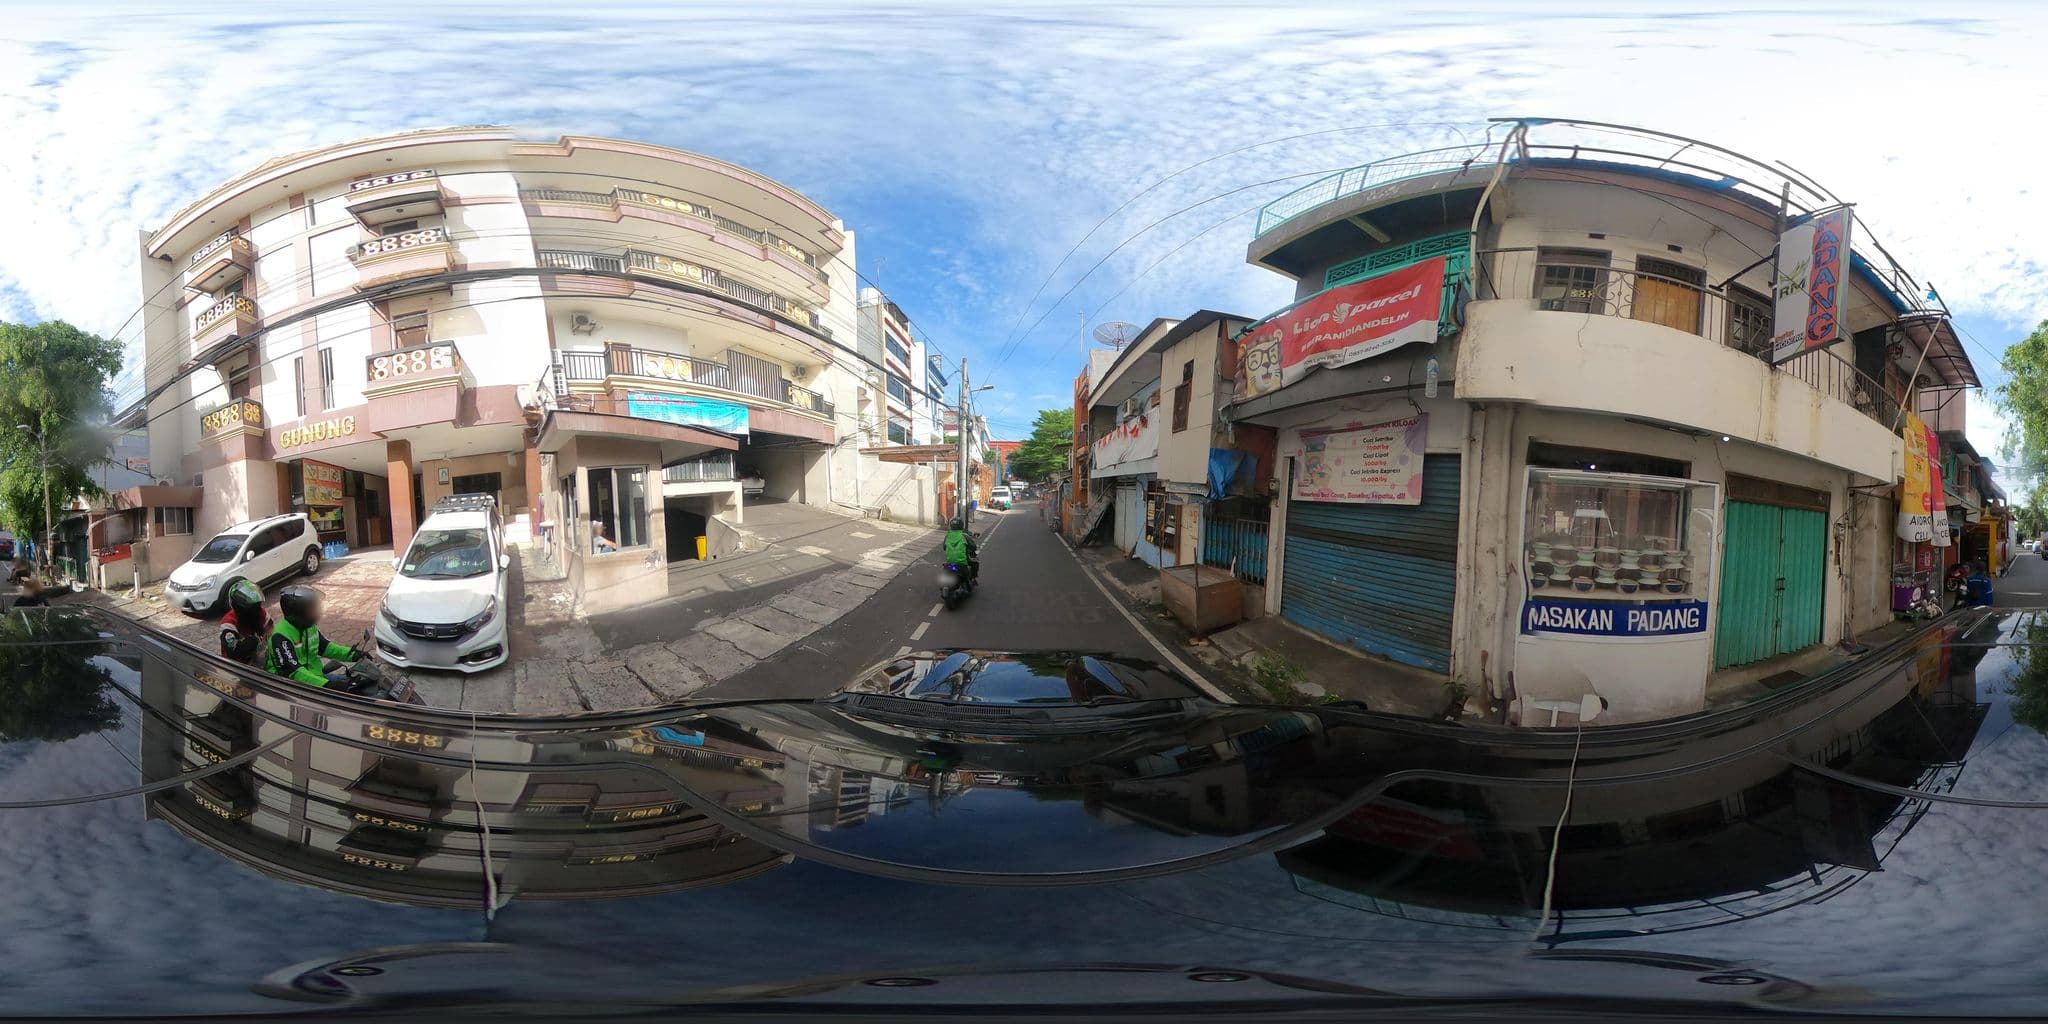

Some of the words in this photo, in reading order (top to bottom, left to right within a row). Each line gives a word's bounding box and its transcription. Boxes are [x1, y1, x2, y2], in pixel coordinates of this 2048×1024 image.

[1293, 312, 1331, 334] Lion
[1350, 284, 1422, 317] parcel
[281, 416, 356, 449] GUNUNG
[1628, 608, 1699, 632] PADANG
